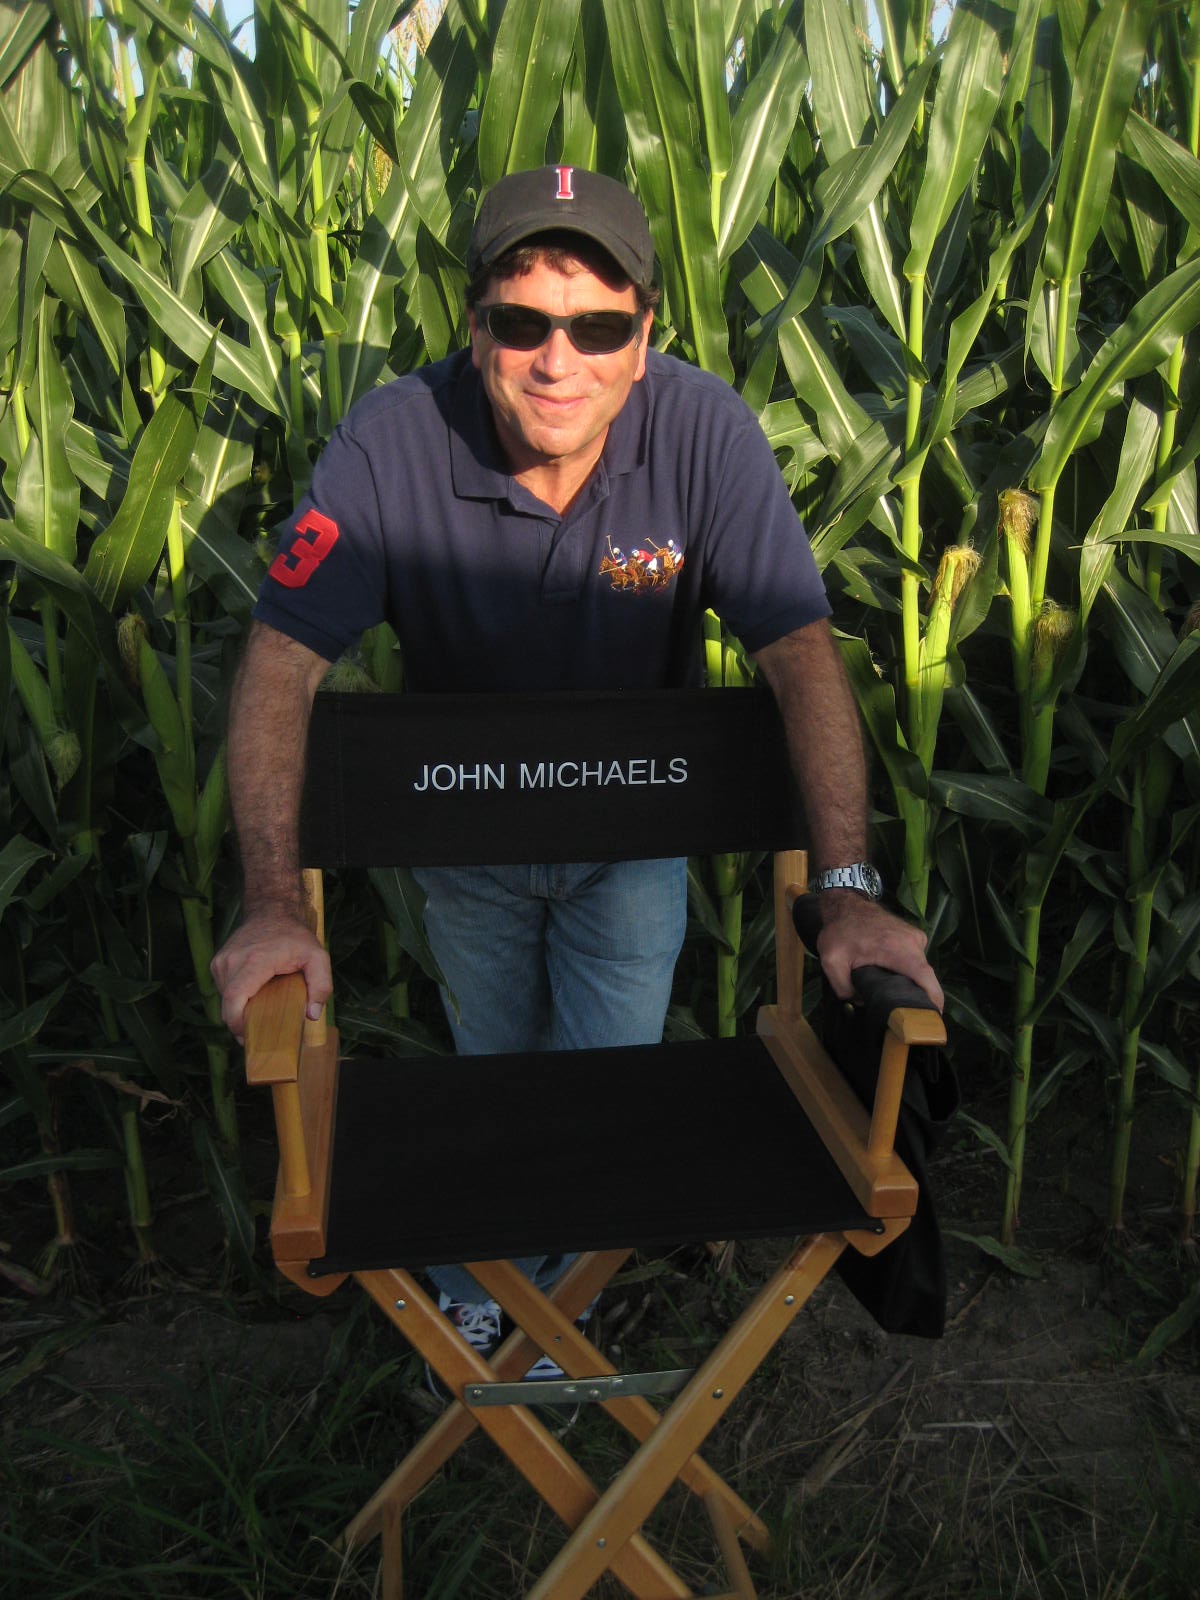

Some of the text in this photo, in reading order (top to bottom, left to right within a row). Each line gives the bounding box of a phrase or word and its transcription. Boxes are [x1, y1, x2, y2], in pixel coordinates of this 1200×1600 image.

[555, 166, 574, 200] I
[269, 508, 340, 588] 3
[413, 757, 688, 791] JOHN MICHAELS
